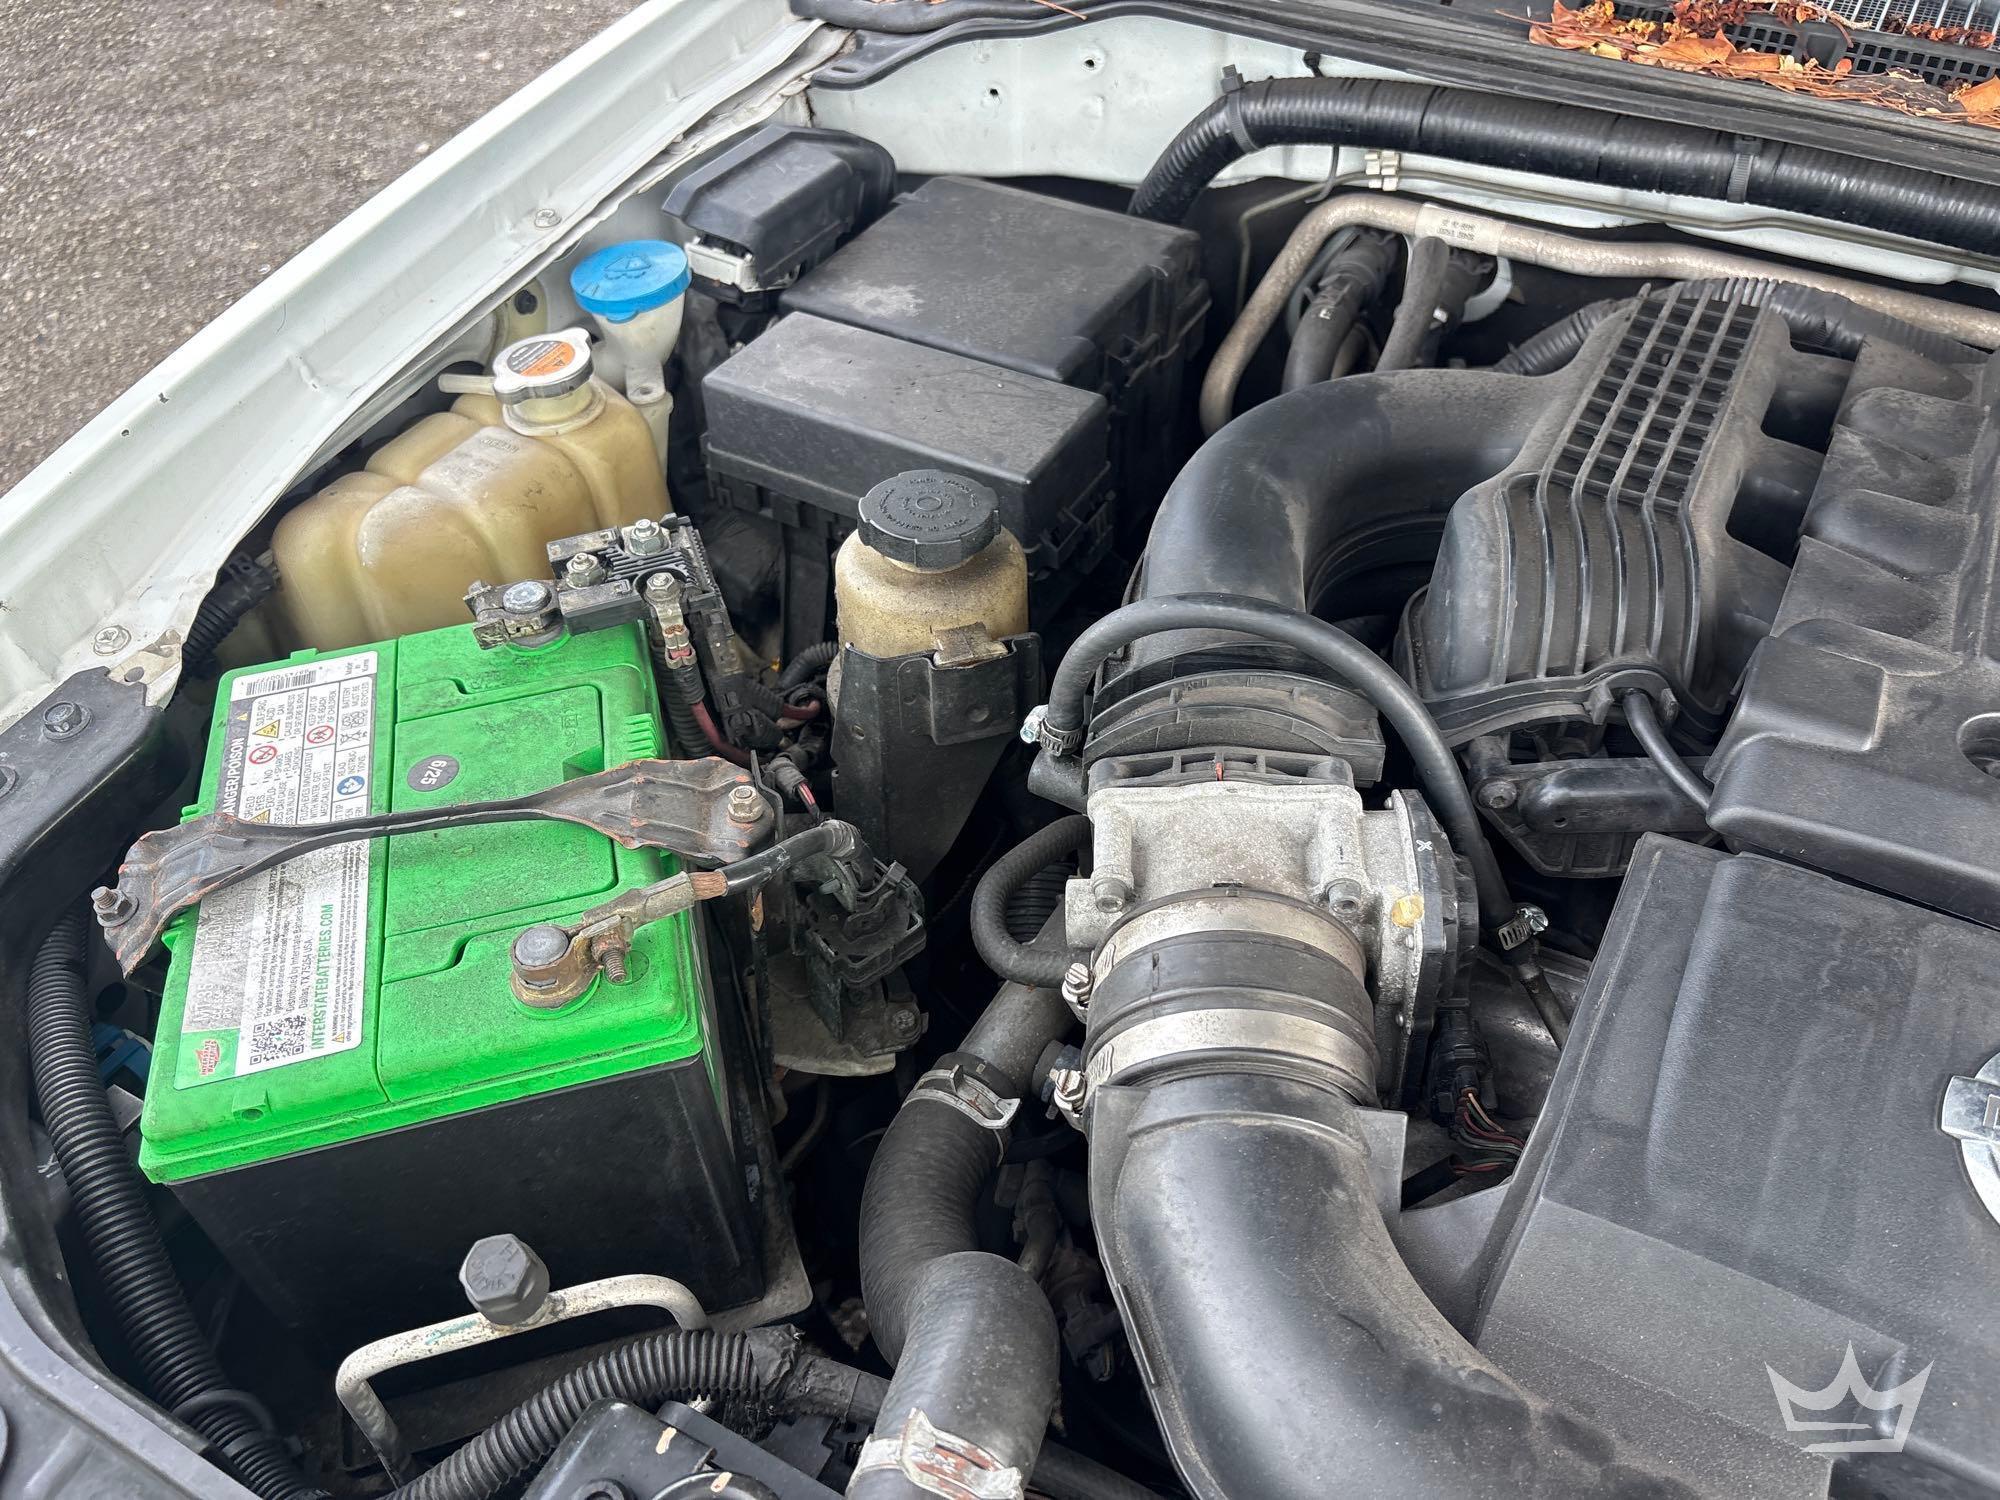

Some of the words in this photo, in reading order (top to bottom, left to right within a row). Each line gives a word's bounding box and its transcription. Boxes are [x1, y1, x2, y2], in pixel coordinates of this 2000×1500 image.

[285, 693, 295, 720] BLINDNESS
[296, 691, 304, 709] BURNS.
[318, 696, 326, 713] REACH
[327, 689, 336, 715] CHILDREN.
[342, 686, 350, 708] BATTERY
[351, 691, 359, 706] MUST
[255, 699, 267, 726] SULFURIC
[265, 707, 275, 721] ACID
[276, 703, 284, 715] CAN
[308, 702, 316, 713] OUT
[294, 709, 303, 727] SEVERE
[307, 712, 315, 726] KEEP
[317, 713, 325, 724] THE
[284, 721, 292, 736] CAUSE
[274, 753, 283, 773] SPARKS
[282, 750, 292, 772] FLAMES
[302, 751, 313, 787] IMMEDIATELY
[322, 760, 331, 776] FAST.
[337, 761, 345, 776] READ
[357, 754, 365, 772] TIONS.
[221, 737, 244, 816] ANGER/POISON
[263, 768, 273, 779] NO
[312, 770, 321, 782] GET
[420, 760, 448, 785] 6/25
[277, 780, 286, 799] CAUSE
[310, 782, 320, 803] WATER.
[321, 776, 330, 791] HELP
[255, 792, 265, 810] EYES.
[265, 786, 276, 808] EXPLO-
[286, 786, 296, 806] INJURY.
[300, 787, 310, 802] EYES
[319, 791, 329, 816] MEDICAL
[244, 795, 254, 818] SHIELD
[275, 799, 284, 811] CAN
[285, 805, 294, 814] OR
[299, 802, 309, 820] FLUSH
[309, 803, 318, 818] WITH
[335, 803, 343, 813] TIP
[264, 904, 275, 926] Canada,
[293, 905, 303, 933] Batteries
[290, 934, 301, 965] Interstate
[302, 937, 312, 953] USA
[259, 951, 270, 974] warranty
[289, 965, 299, 974] by
[300, 952, 311, 975] 75254
[257, 974, 268, 990] under
[276, 964, 285, 988] Batteries
[300, 974, 309, 985] TX
[310, 902, 333, 1050] INTERSTATEBATTERIES.COM
[193, 982, 213, 1021] MT-35
[255, 990, 266, 1011] replace
[265, 987, 274, 1007] limited
[274, 988, 283, 1015] Interstate
[286, 974, 298, 1011] Distributed
[298, 985, 309, 1009] Dallas,
[200, 1040, 210, 1074] INTERSTATE
[206, 1039, 217, 1073] BATTERIES
